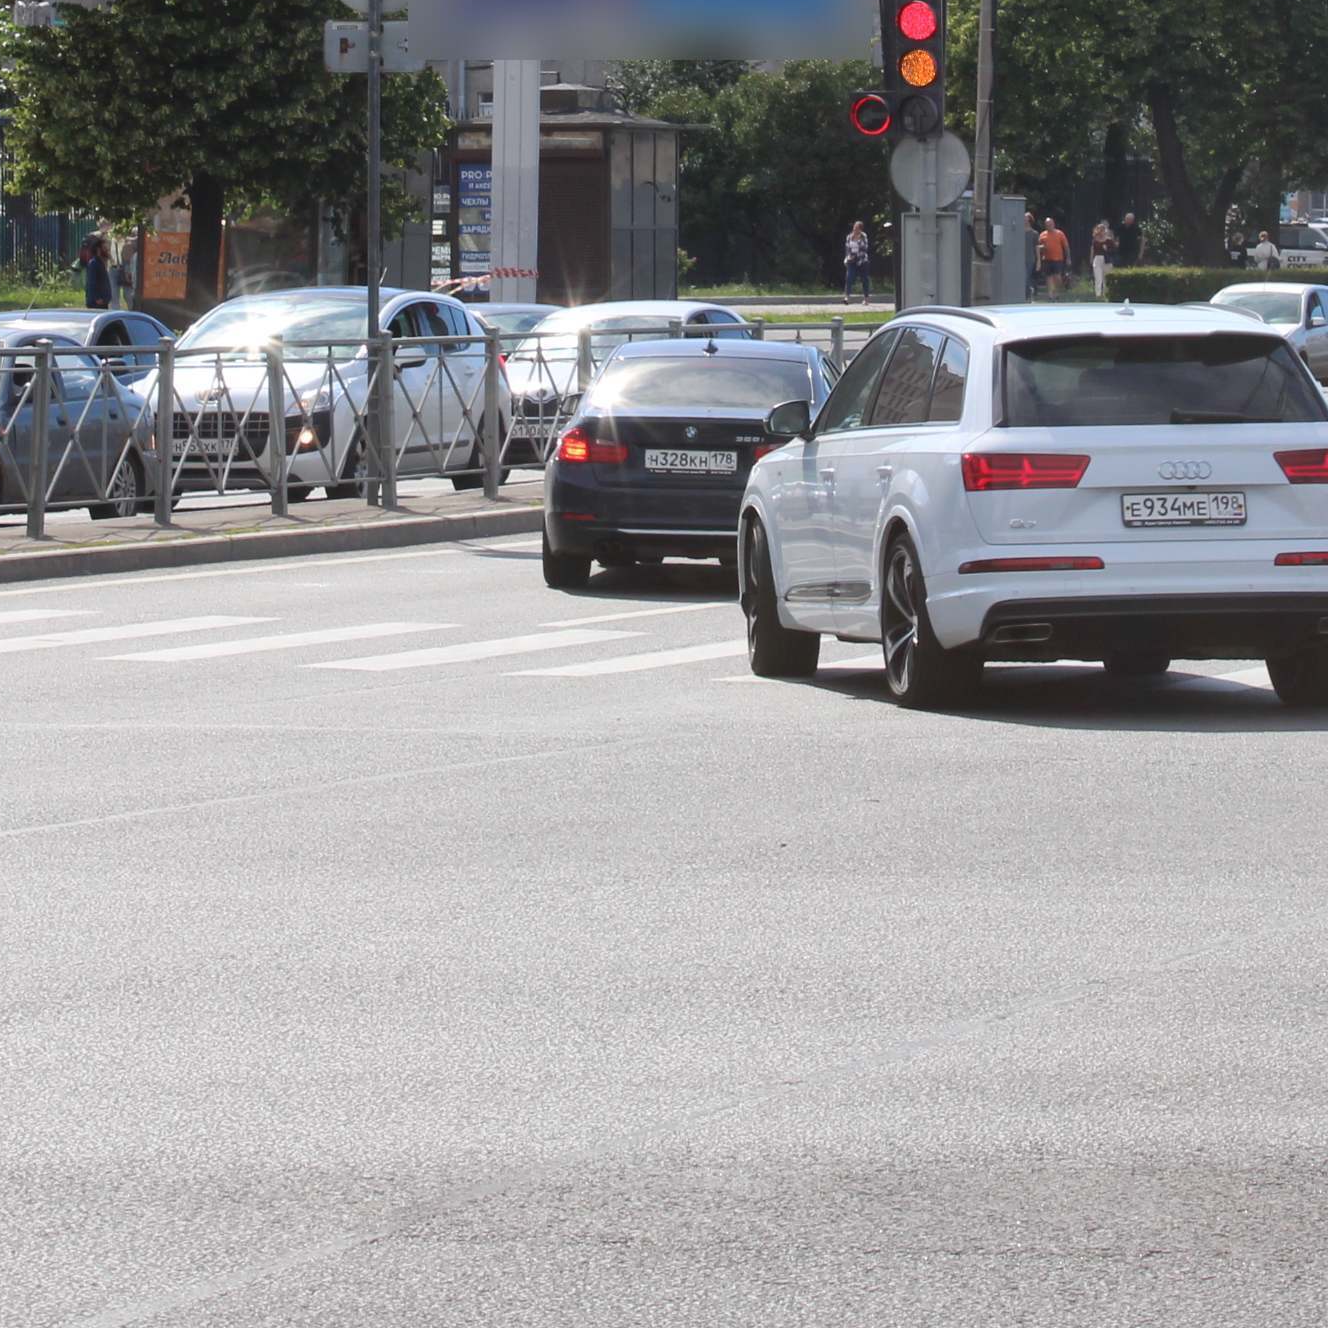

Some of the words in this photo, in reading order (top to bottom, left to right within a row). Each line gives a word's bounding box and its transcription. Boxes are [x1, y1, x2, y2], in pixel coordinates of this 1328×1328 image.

[650, 452, 708, 467] Н328КН
[712, 453, 732, 465] 178
[1131, 492, 1207, 517] Е934МЕ
[1212, 495, 1240, 511] 198
